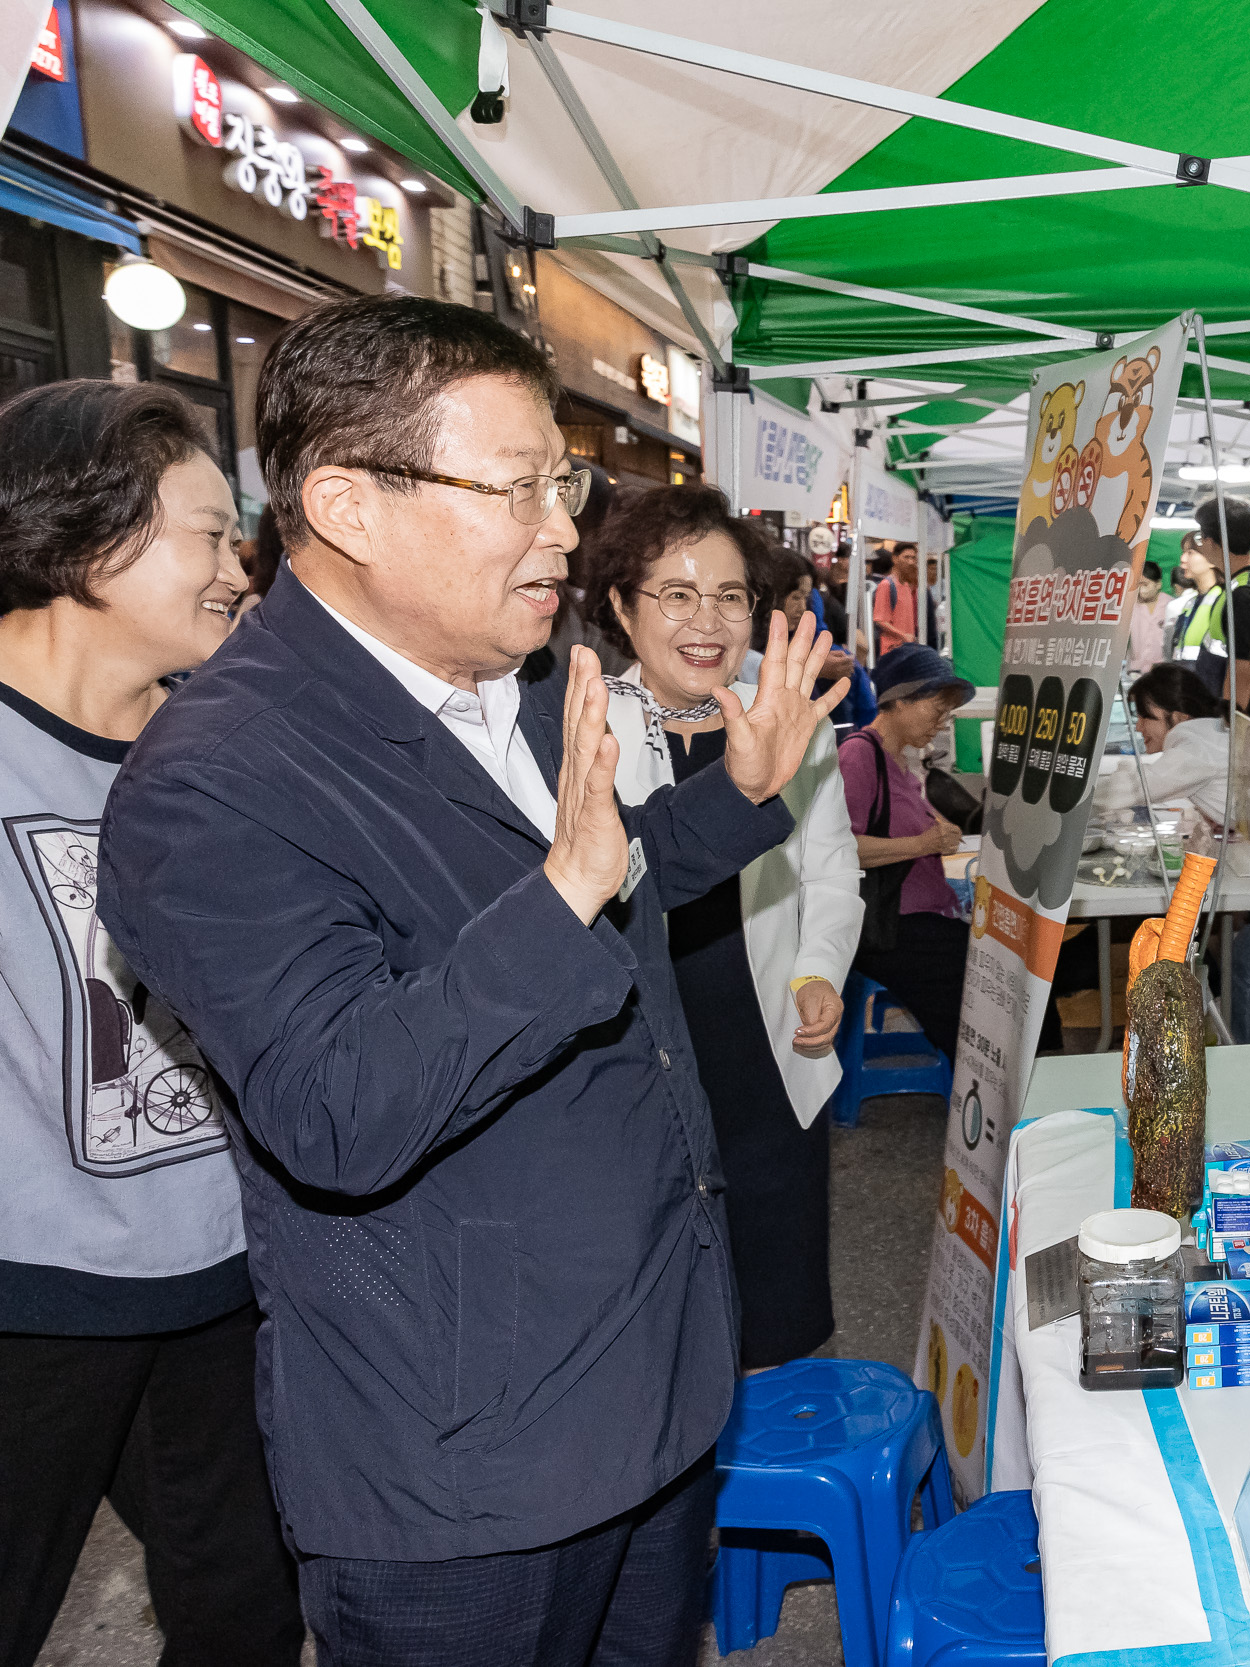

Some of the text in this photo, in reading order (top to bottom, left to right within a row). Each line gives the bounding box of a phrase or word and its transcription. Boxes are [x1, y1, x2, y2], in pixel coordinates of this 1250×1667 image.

[1000, 703, 1028, 737] 4,000
[1035, 708, 1058, 741] 250
[1066, 711, 1087, 745] 50
[1205, 1286, 1230, 1321] 니코틴엘
[1198, 1333, 1207, 1342] 20
[1200, 1355, 1209, 1363] 20
[1201, 1378, 1210, 1386] 20
